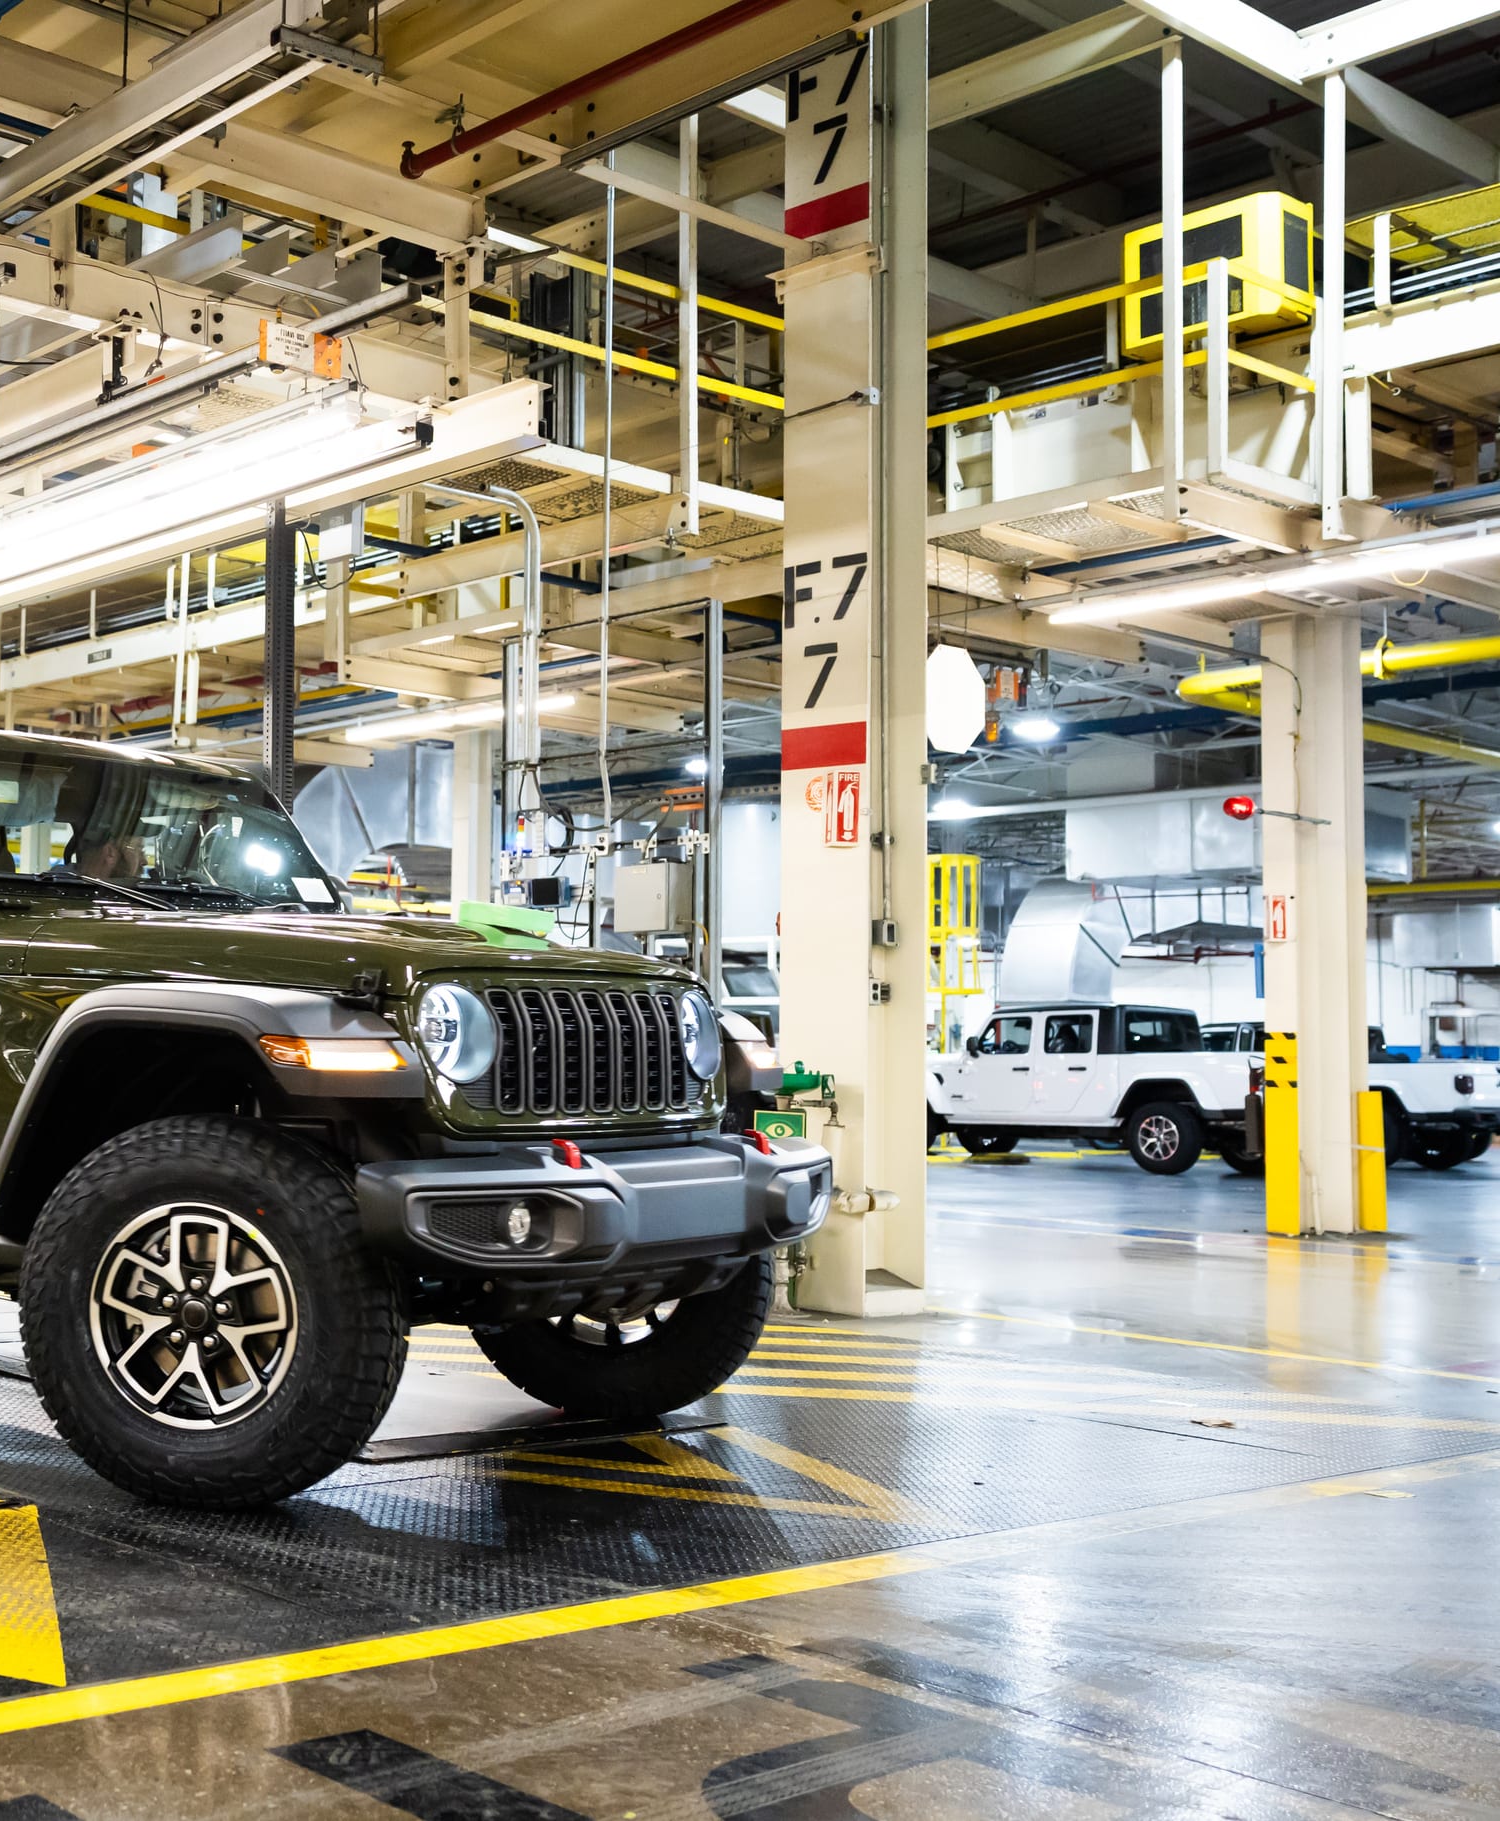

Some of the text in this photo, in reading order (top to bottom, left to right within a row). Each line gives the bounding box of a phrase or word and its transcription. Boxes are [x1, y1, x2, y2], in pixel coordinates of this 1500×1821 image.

[813, 113, 848, 185] 7
[784, 552, 868, 629] F.7
[804, 642, 838, 709] 7
[839, 773, 859, 782] FIRE
